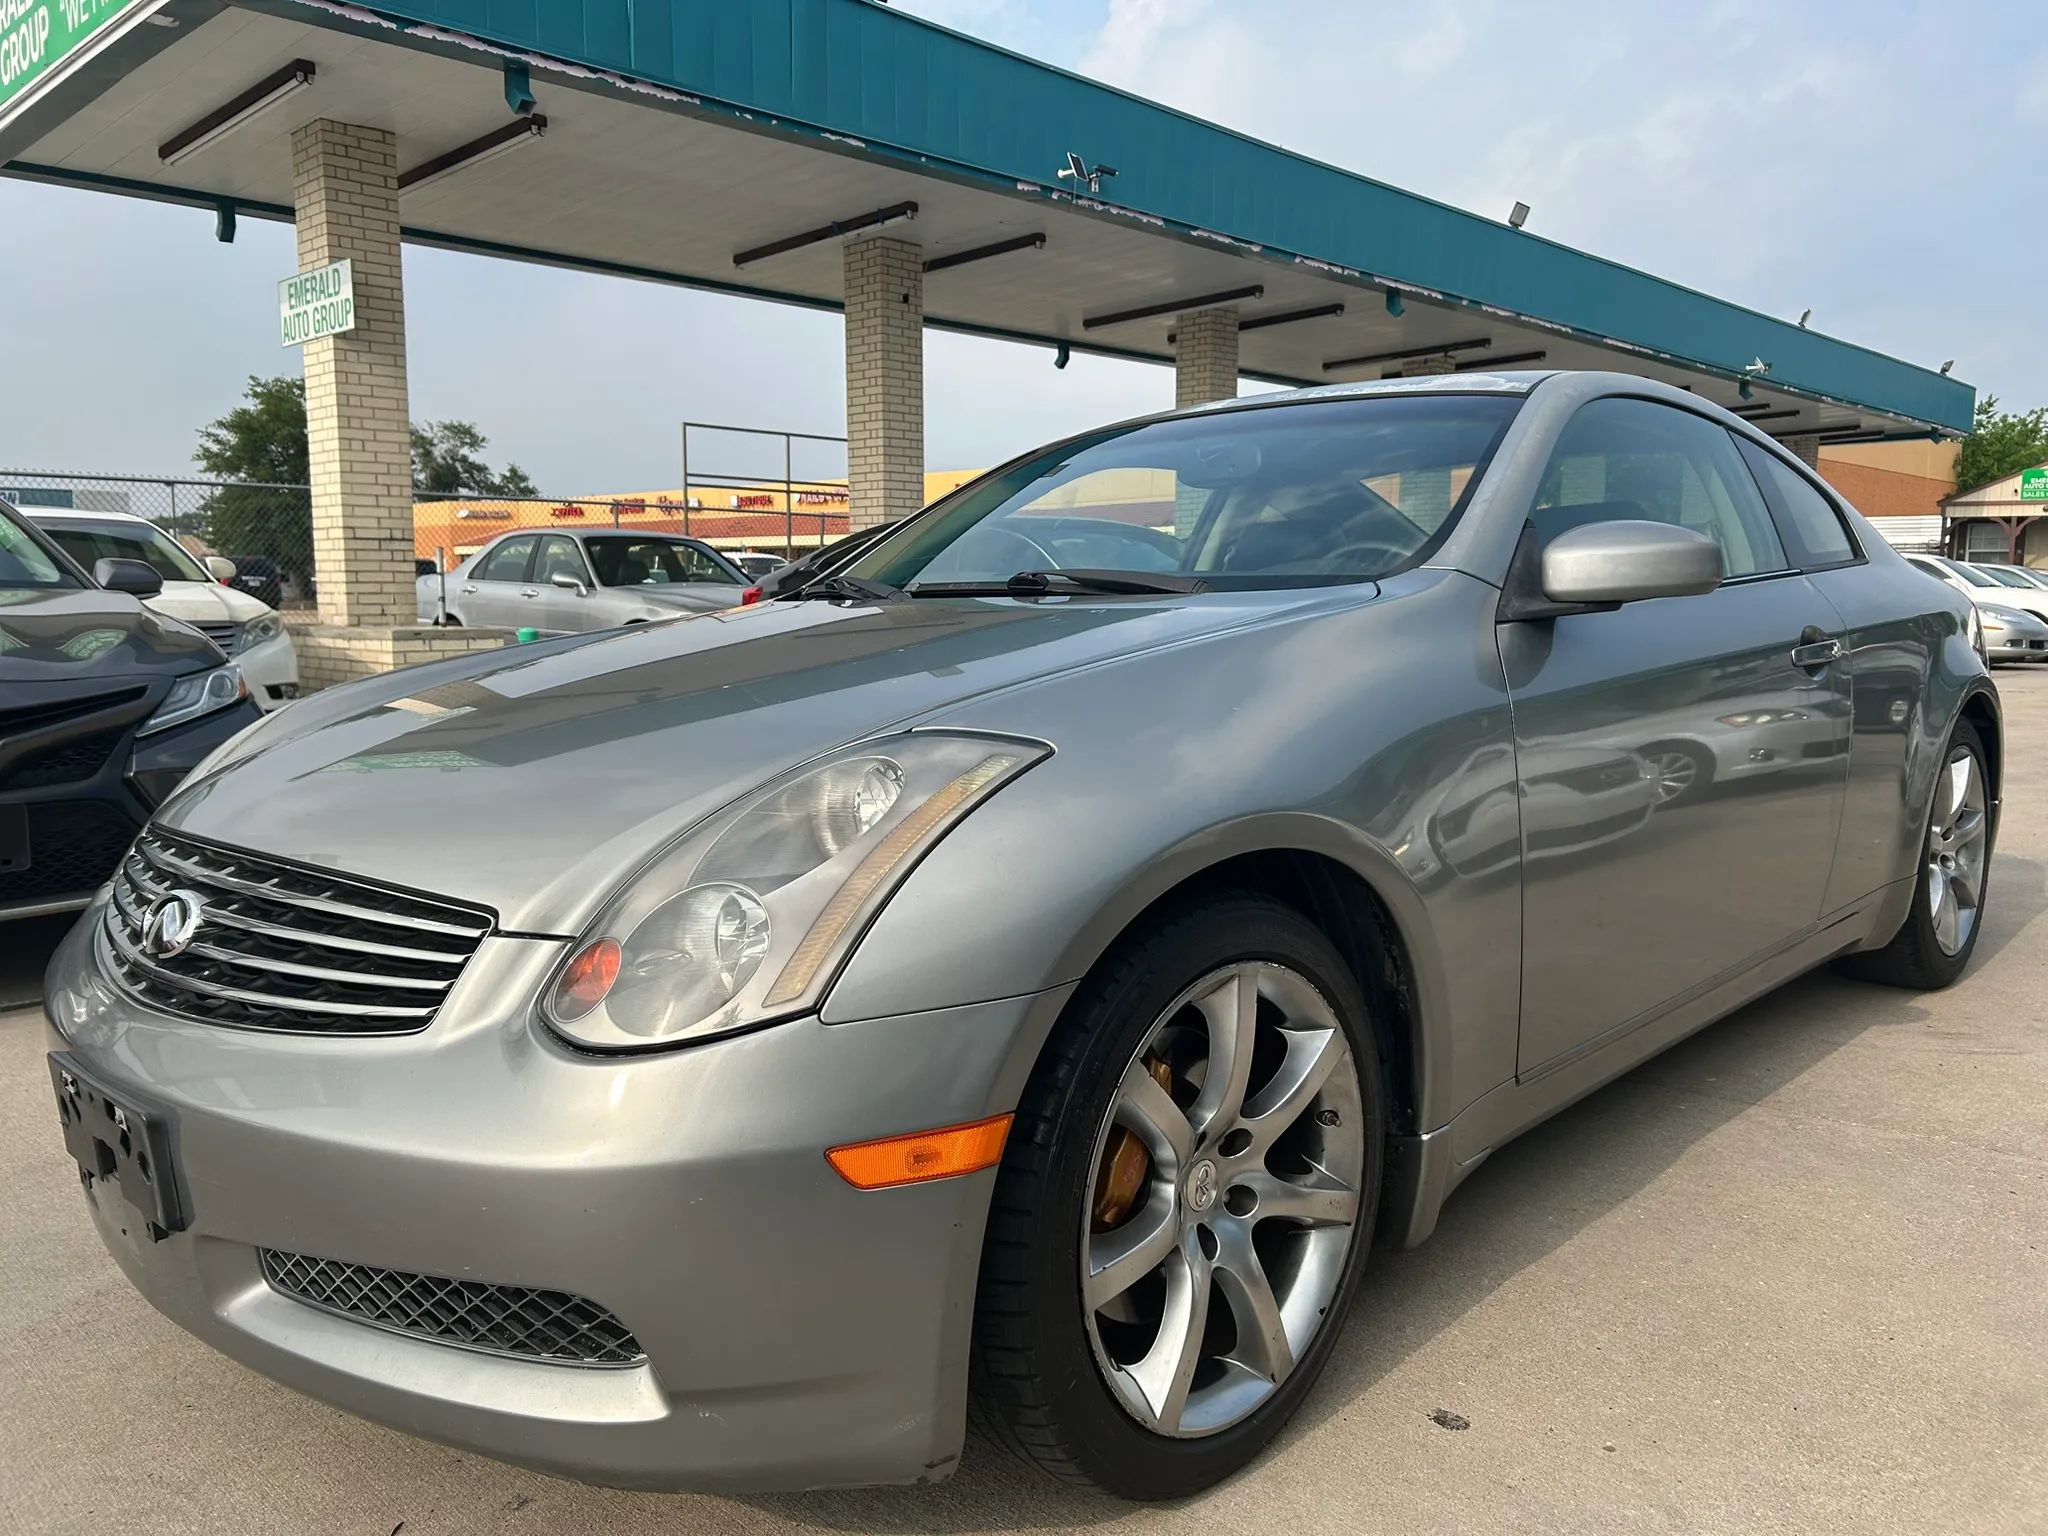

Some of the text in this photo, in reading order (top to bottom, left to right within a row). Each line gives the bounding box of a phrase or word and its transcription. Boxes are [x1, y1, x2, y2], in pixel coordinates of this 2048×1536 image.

[1, 5, 49, 86] GROUP
[288, 268, 341, 310] EMERALD
[283, 297, 352, 343] AUTO GROUP
